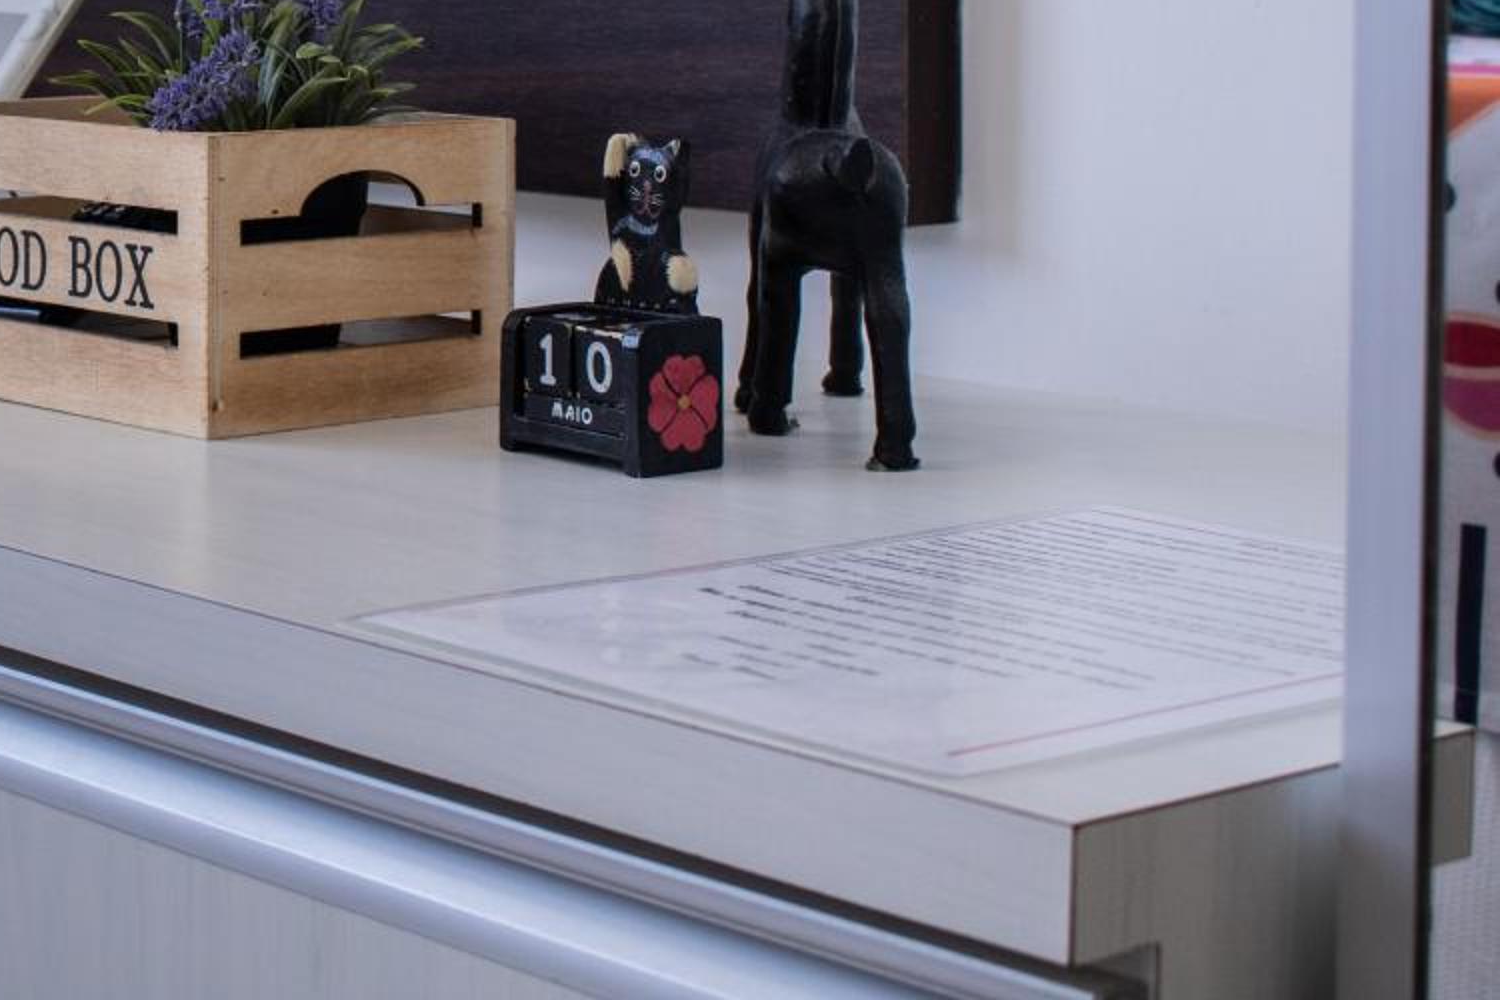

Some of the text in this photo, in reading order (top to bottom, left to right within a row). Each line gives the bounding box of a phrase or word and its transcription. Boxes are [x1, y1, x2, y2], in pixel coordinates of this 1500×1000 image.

[67, 235, 154, 310] BOX
[538, 333, 613, 393] 10
[552, 401, 593, 424] MAIO
